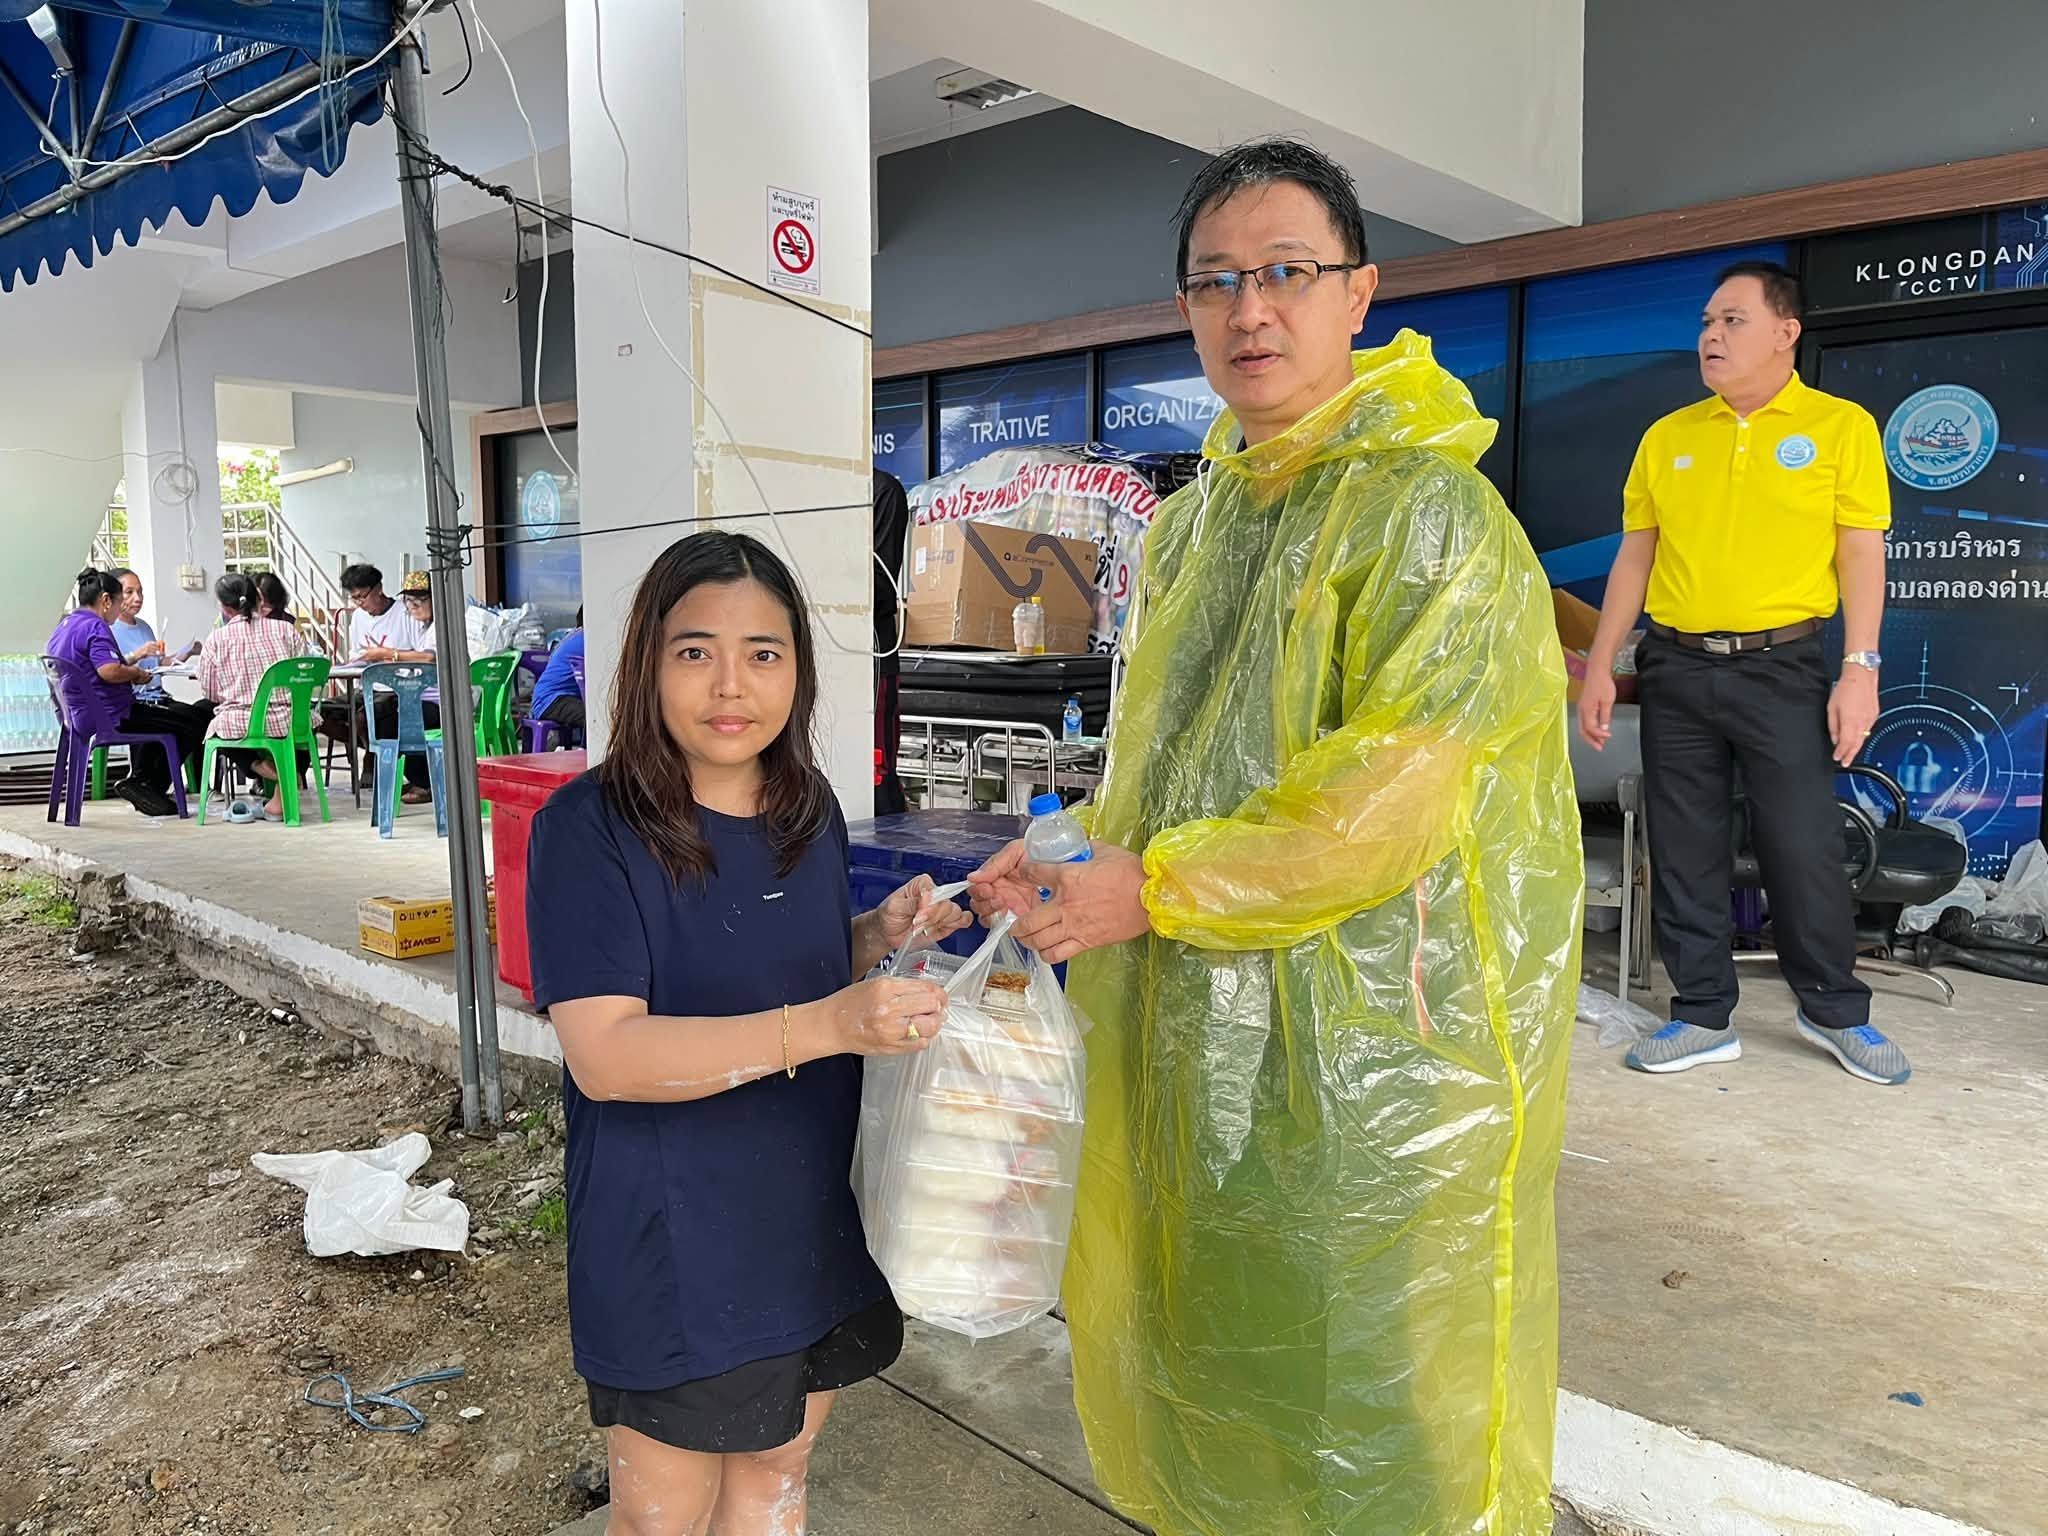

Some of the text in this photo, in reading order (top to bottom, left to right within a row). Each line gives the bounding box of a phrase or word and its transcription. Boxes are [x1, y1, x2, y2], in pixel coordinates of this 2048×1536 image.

[1856, 243, 2033, 282] KLONGDAN
[1911, 274, 1977, 295] CCTV
[969, 415, 1050, 444] TRATIVE
